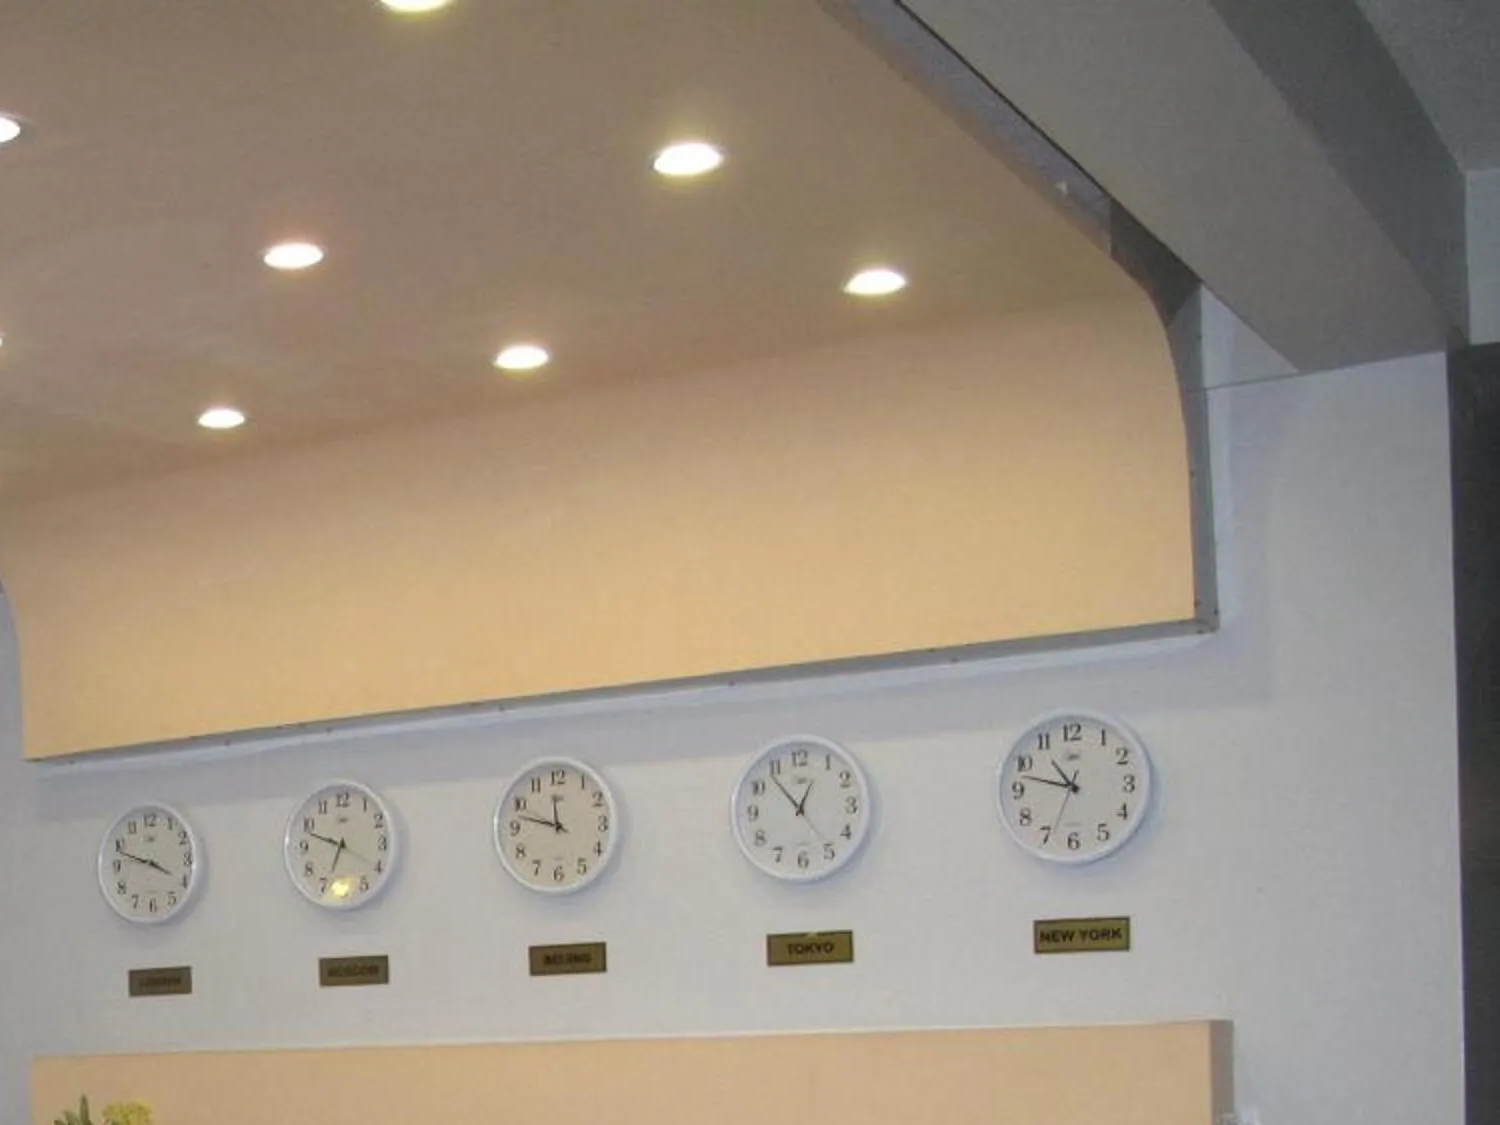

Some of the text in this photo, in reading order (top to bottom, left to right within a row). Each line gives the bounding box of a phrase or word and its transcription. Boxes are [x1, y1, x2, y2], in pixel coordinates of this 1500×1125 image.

[1038, 733, 1050, 750] 11
[1063, 723, 1082, 742] 12
[791, 749, 808, 768] 12
[1017, 755, 1033, 772] 10
[1115, 747, 1129, 765] 2
[769, 759, 781, 776] 11
[531, 776, 541, 793] 11
[550, 768, 565, 786] 12
[839, 770, 851, 789] 2
[1123, 774, 1135, 793] 3
[752, 780, 765, 795] 10
[1011, 780, 1025, 800] 9
[515, 797, 527, 812] 10
[592, 791, 603, 808] 2
[845, 796, 857, 814] 3
[747, 804, 759, 822] 9
[1019, 808, 1032, 827] 8
[1116, 803, 1128, 820] 4
[510, 820, 520, 837] 9
[598, 815, 608, 832] 3
[839, 823, 851, 841] 4
[1097, 823, 1110, 842] 5
[754, 829, 766, 847] 8
[1040, 825, 1052, 845] 7
[1067, 832, 1081, 850] 6
[516, 842, 525, 859] 8
[593, 840, 602, 857] 4
[772, 846, 783, 863] 7
[823, 842, 835, 861] 5
[532, 859, 540, 877] 7
[577, 857, 587, 875] 5
[797, 849, 810, 869] 6
[553, 865, 564, 881] 6
[1040, 926, 1122, 944] NEW YORK
[786, 941, 835, 955] TOKYO
